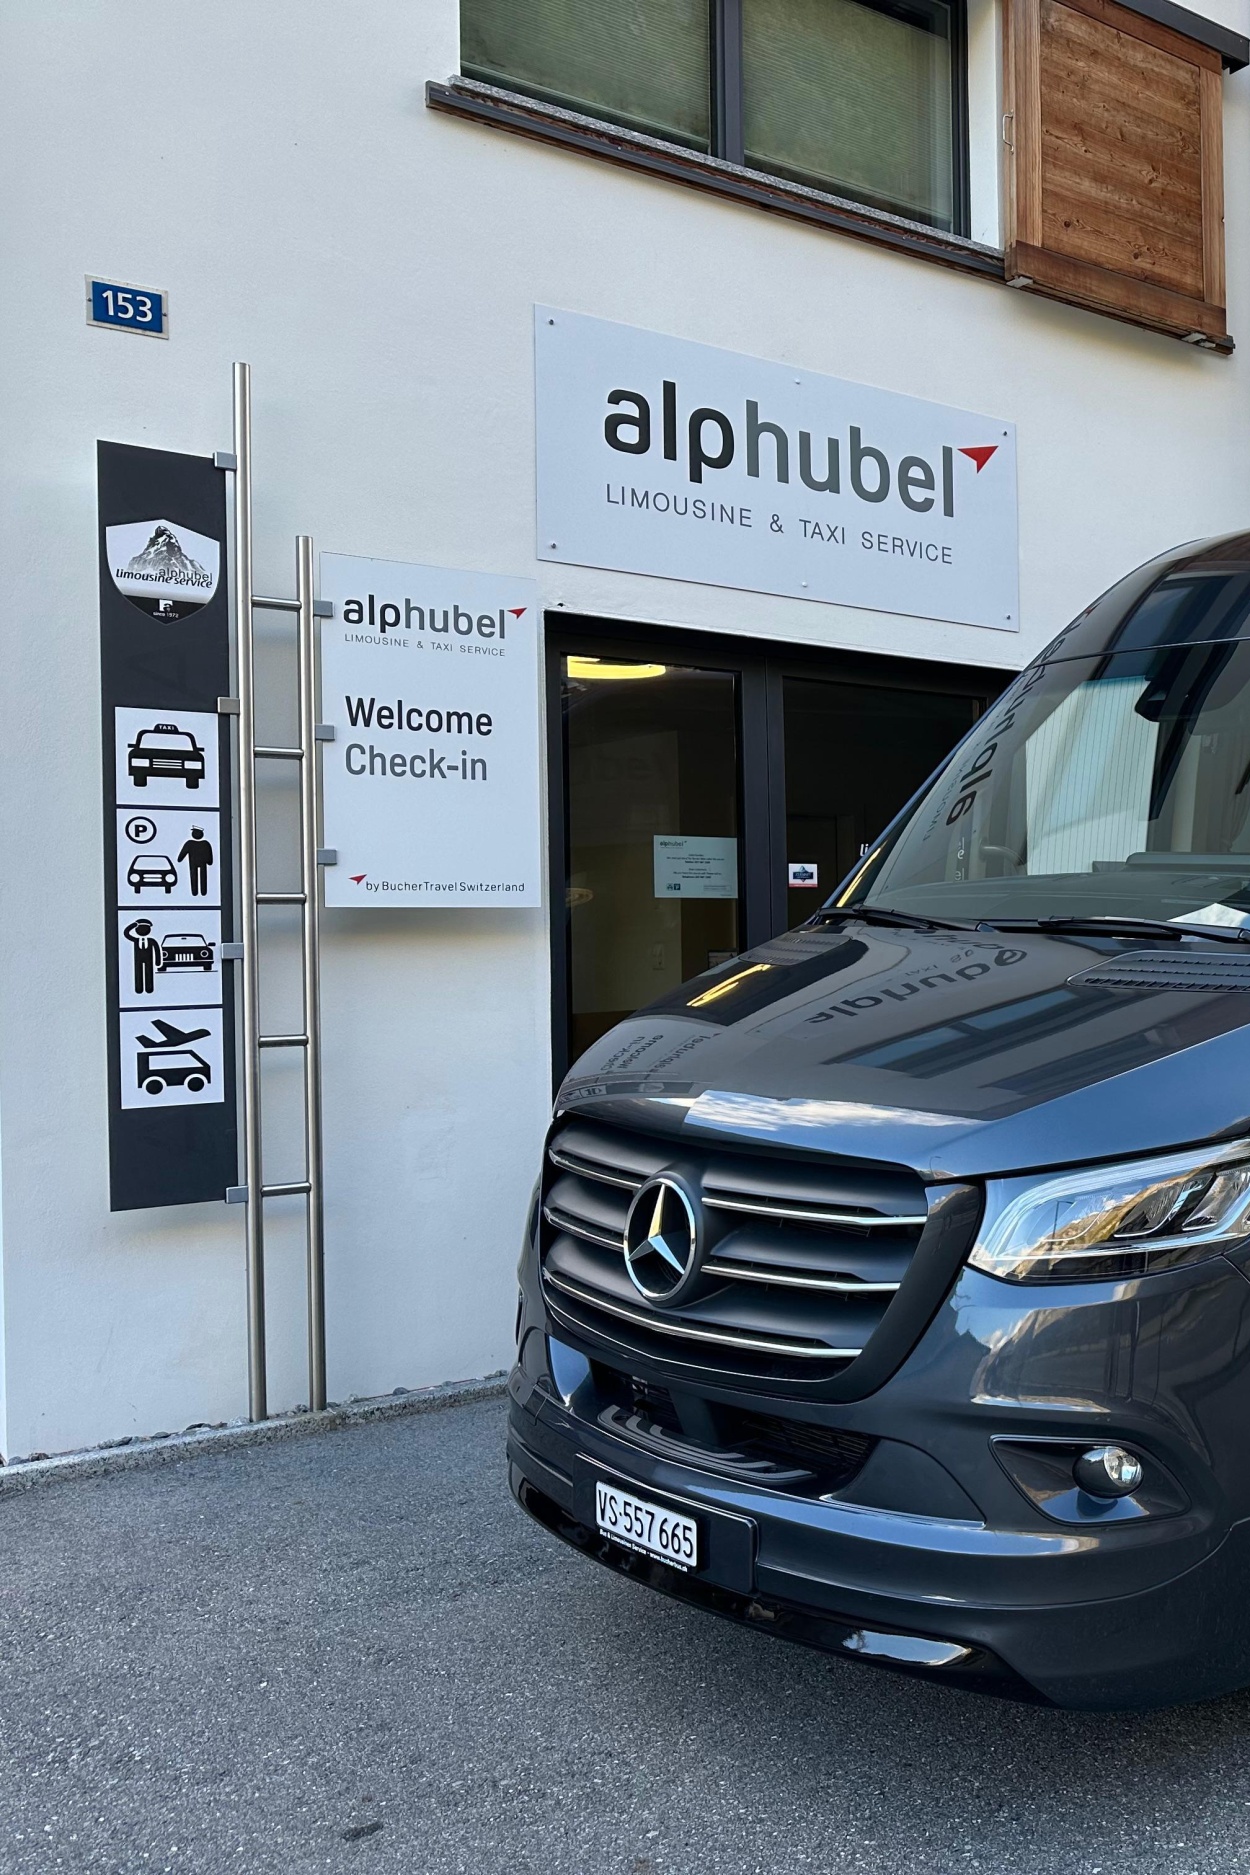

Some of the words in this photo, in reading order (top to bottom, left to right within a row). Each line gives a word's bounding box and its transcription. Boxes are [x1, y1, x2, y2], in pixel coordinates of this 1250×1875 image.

[102, 290, 153, 322] 153
[604, 380, 955, 518] alphubel
[606, 483, 753, 528] LIMOUSINE
[769, 514, 785, 534] &
[799, 519, 846, 545] TAXI
[861, 531, 954, 565] SERVICE
[115, 568, 172, 583] limousine
[174, 577, 213, 588] service
[159, 567, 213, 581] alphubel
[343, 594, 506, 639] alphubel
[344, 633, 409, 648] LIMOUSINE
[416, 640, 424, 649] &
[431, 641, 453, 652] TAXI
[459, 644, 506, 657] SERVICE
[345, 695, 493, 736] Welcome
[345, 743, 488, 781] Check-in
[134, 824, 148, 837] P
[366, 881, 380, 893] by
